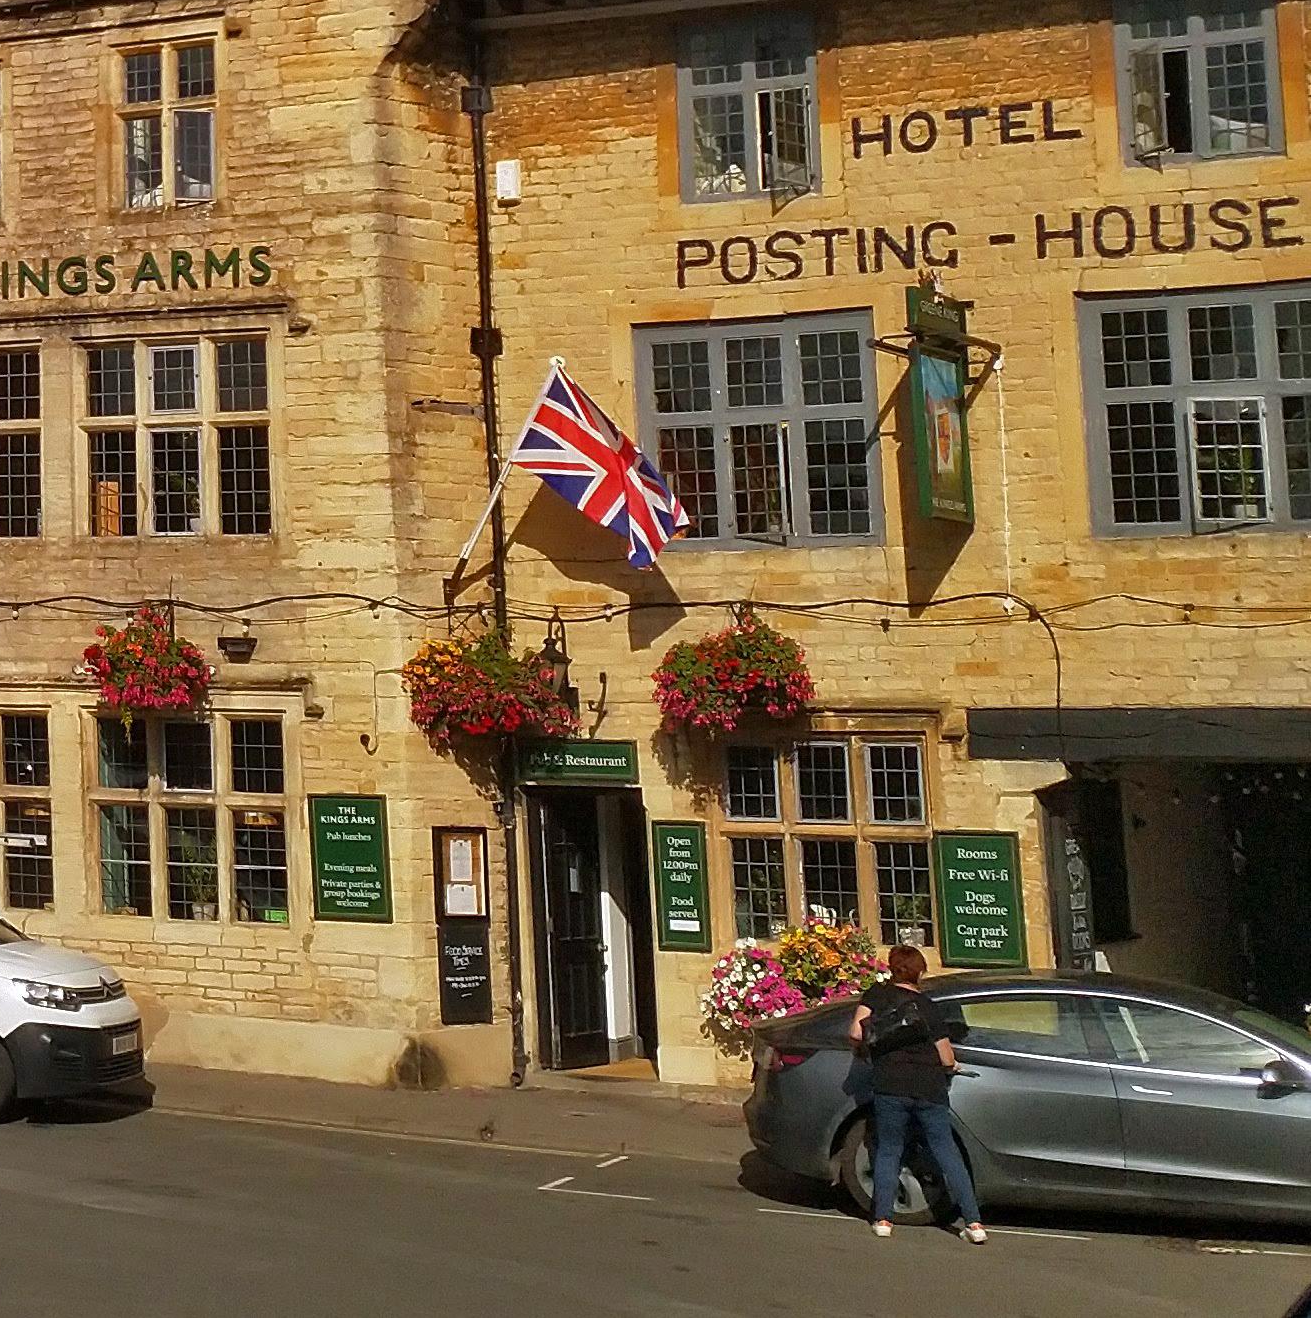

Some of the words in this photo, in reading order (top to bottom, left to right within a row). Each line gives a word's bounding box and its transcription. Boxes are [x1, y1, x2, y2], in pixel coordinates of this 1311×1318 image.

[851, 99, 1083, 160] HOTEL
[677, 221, 960, 289] POSTING
[1034, 196, 1305, 259] HOUSE
[131, 245, 273, 292] ARMS
[553, 754, 563, 766] &
[564, 754, 627, 767] Restaurant
[338, 806, 356, 815] THE
[321, 815, 349, 824] KINGS
[351, 816, 376, 825] ARMS
[326, 832, 342, 840] Pub
[342, 832, 372, 841] lunches
[667, 836, 691, 847] Open
[669, 848, 691, 858] from
[957, 848, 998, 860] Rooms
[324, 863, 355, 873] Evening
[355, 864, 377, 873] meals
[670, 872, 693, 884] daily
[948, 868, 976, 881] Free
[977, 869, 1009, 881] Wi-fi
[321, 879, 348, 888] Private
[348, 880, 375, 890] parties
[375, 881, 382, 890] &
[323, 889, 346, 899] group
[346, 889, 381, 900] bookings
[964, 890, 996, 905] Dogs
[336, 899, 369, 908] welcome
[671, 896, 694, 907] Food
[668, 908, 698, 919] served
[955, 903, 1009, 916] welcome
[957, 924, 979, 936] Car
[980, 925, 1009, 938] park
[964, 938, 977, 948] at
[978, 939, 1004, 949] rear
